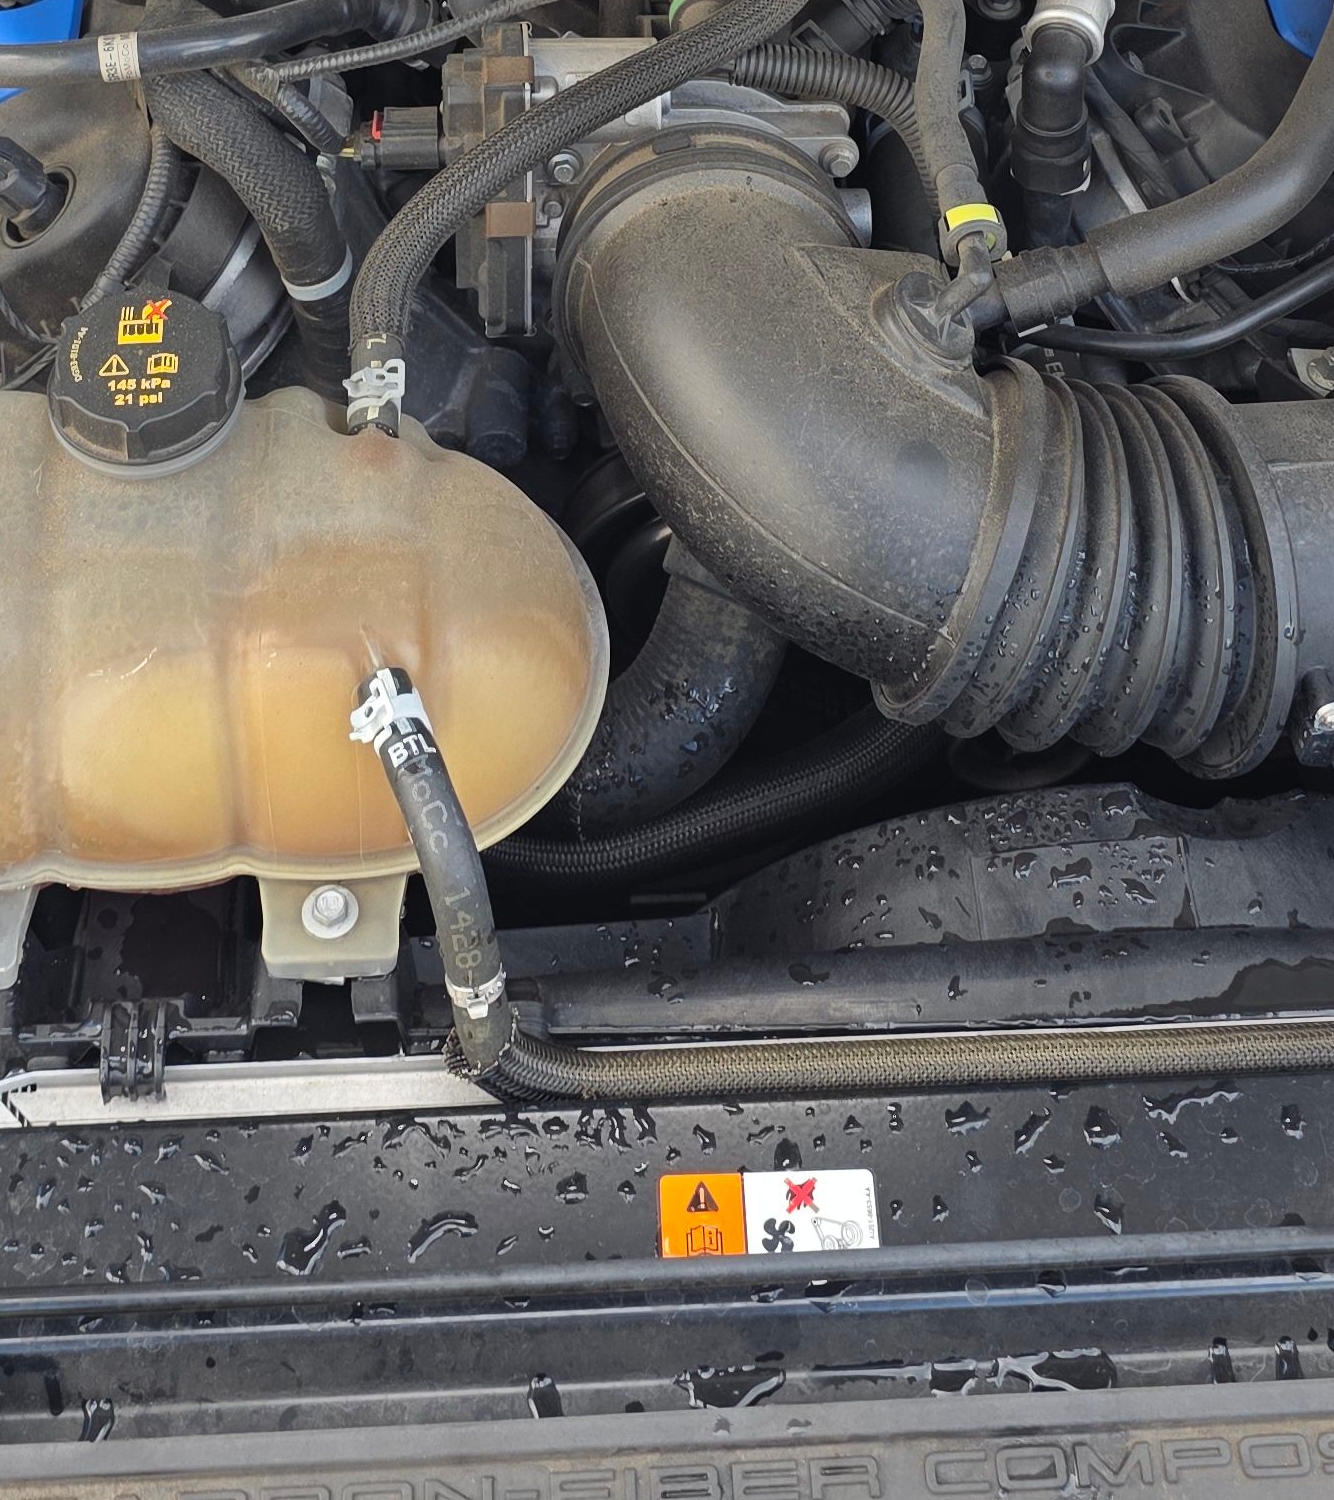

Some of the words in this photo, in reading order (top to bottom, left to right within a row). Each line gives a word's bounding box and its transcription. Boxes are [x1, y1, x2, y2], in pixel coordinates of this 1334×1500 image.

[107, 378, 137, 392] 145
[140, 377, 171, 390] kPa
[114, 392, 133, 406] 21
[138, 391, 163, 407] psi
[387, 733, 437, 768] BTL
